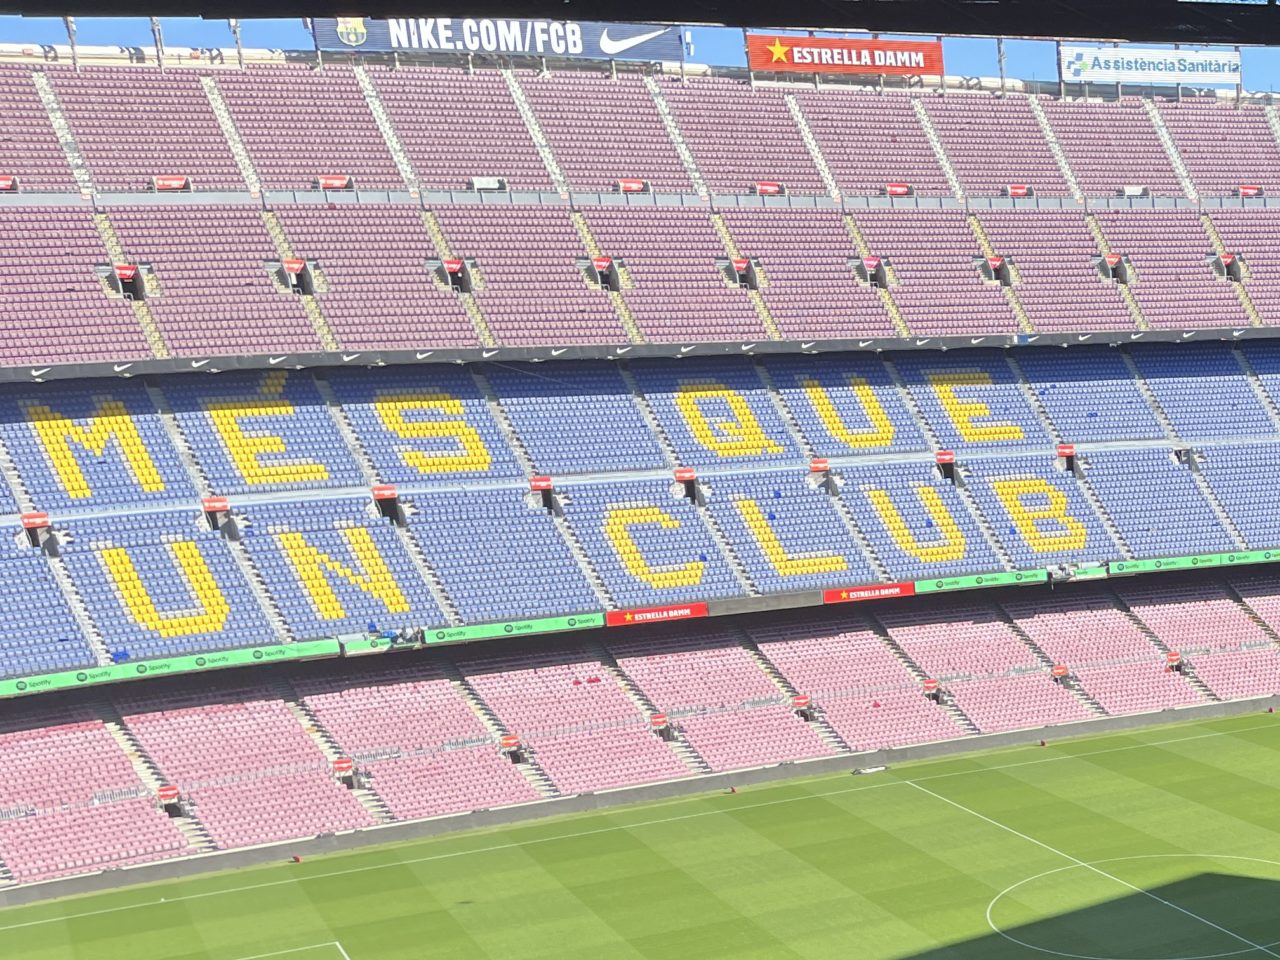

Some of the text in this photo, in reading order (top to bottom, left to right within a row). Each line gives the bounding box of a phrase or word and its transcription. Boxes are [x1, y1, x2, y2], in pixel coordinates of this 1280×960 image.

[388, 18, 584, 54] NIKE.COM/FCB
[792, 47, 925, 68] ESTRELLA DAMM
[1091, 55, 1176, 72] Assistència
[676, 372, 1023, 457] QUE
[101, 478, 1088, 637] UN CLUB
[849, 587, 900, 599] ESTRELLA DAMM
[634, 608, 691, 621] ESTRELLA DAMM
[577, 616, 596, 625] Spotify
[446, 630, 466, 639] Spotify
[265, 648, 286, 657] Spotify
[208, 654, 229, 664] Spotify
[149, 662, 172, 672] Spotify
[88, 671, 111, 681] Spotify
[28, 679, 51, 689] Spotify
